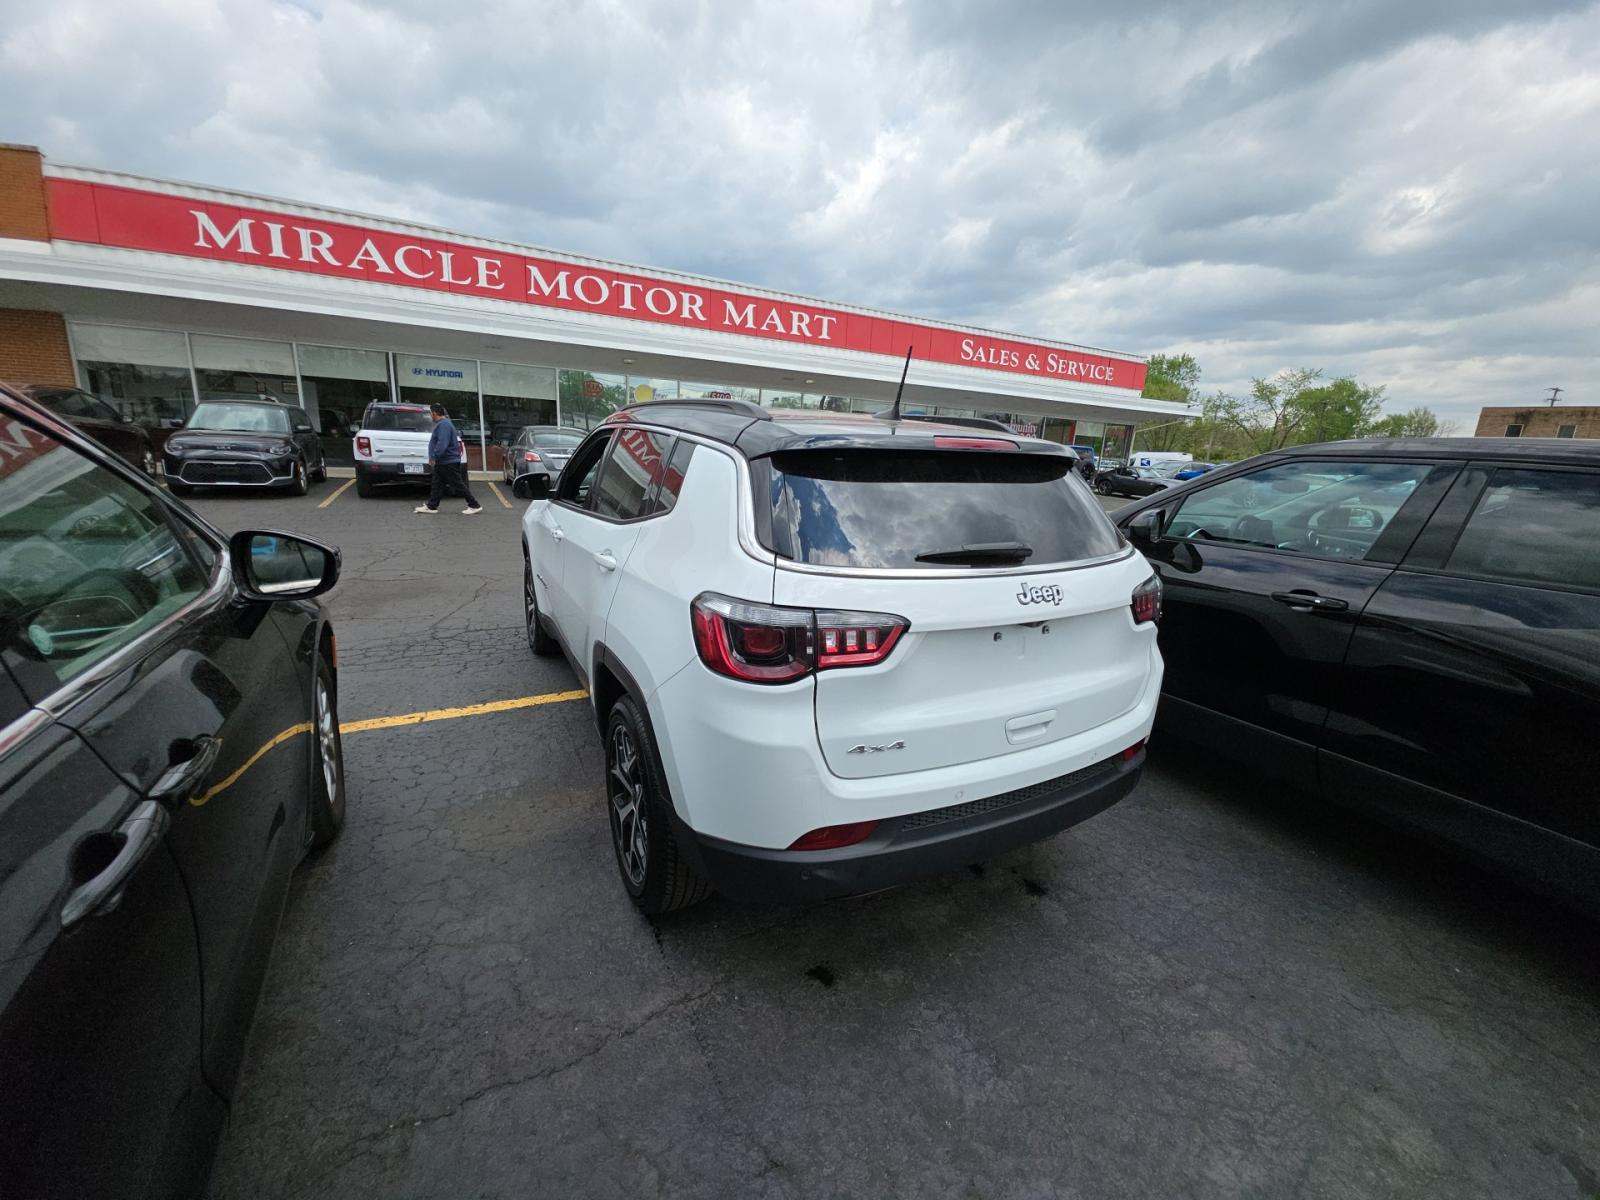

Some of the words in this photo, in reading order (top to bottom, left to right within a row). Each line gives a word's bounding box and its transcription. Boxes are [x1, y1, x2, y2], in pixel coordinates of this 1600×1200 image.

[188, 209, 505, 290] MIRACLE
[525, 264, 707, 321] MOTOR
[721, 299, 837, 340] MART
[960, 339, 1019, 368] SALES
[1025, 353, 1041, 371] &
[1046, 353, 1114, 381] SERVICE
[425, 368, 463, 378] HYUNDAI
[1017, 582, 1064, 606] Jeep
[847, 740, 906, 754] 4x4
